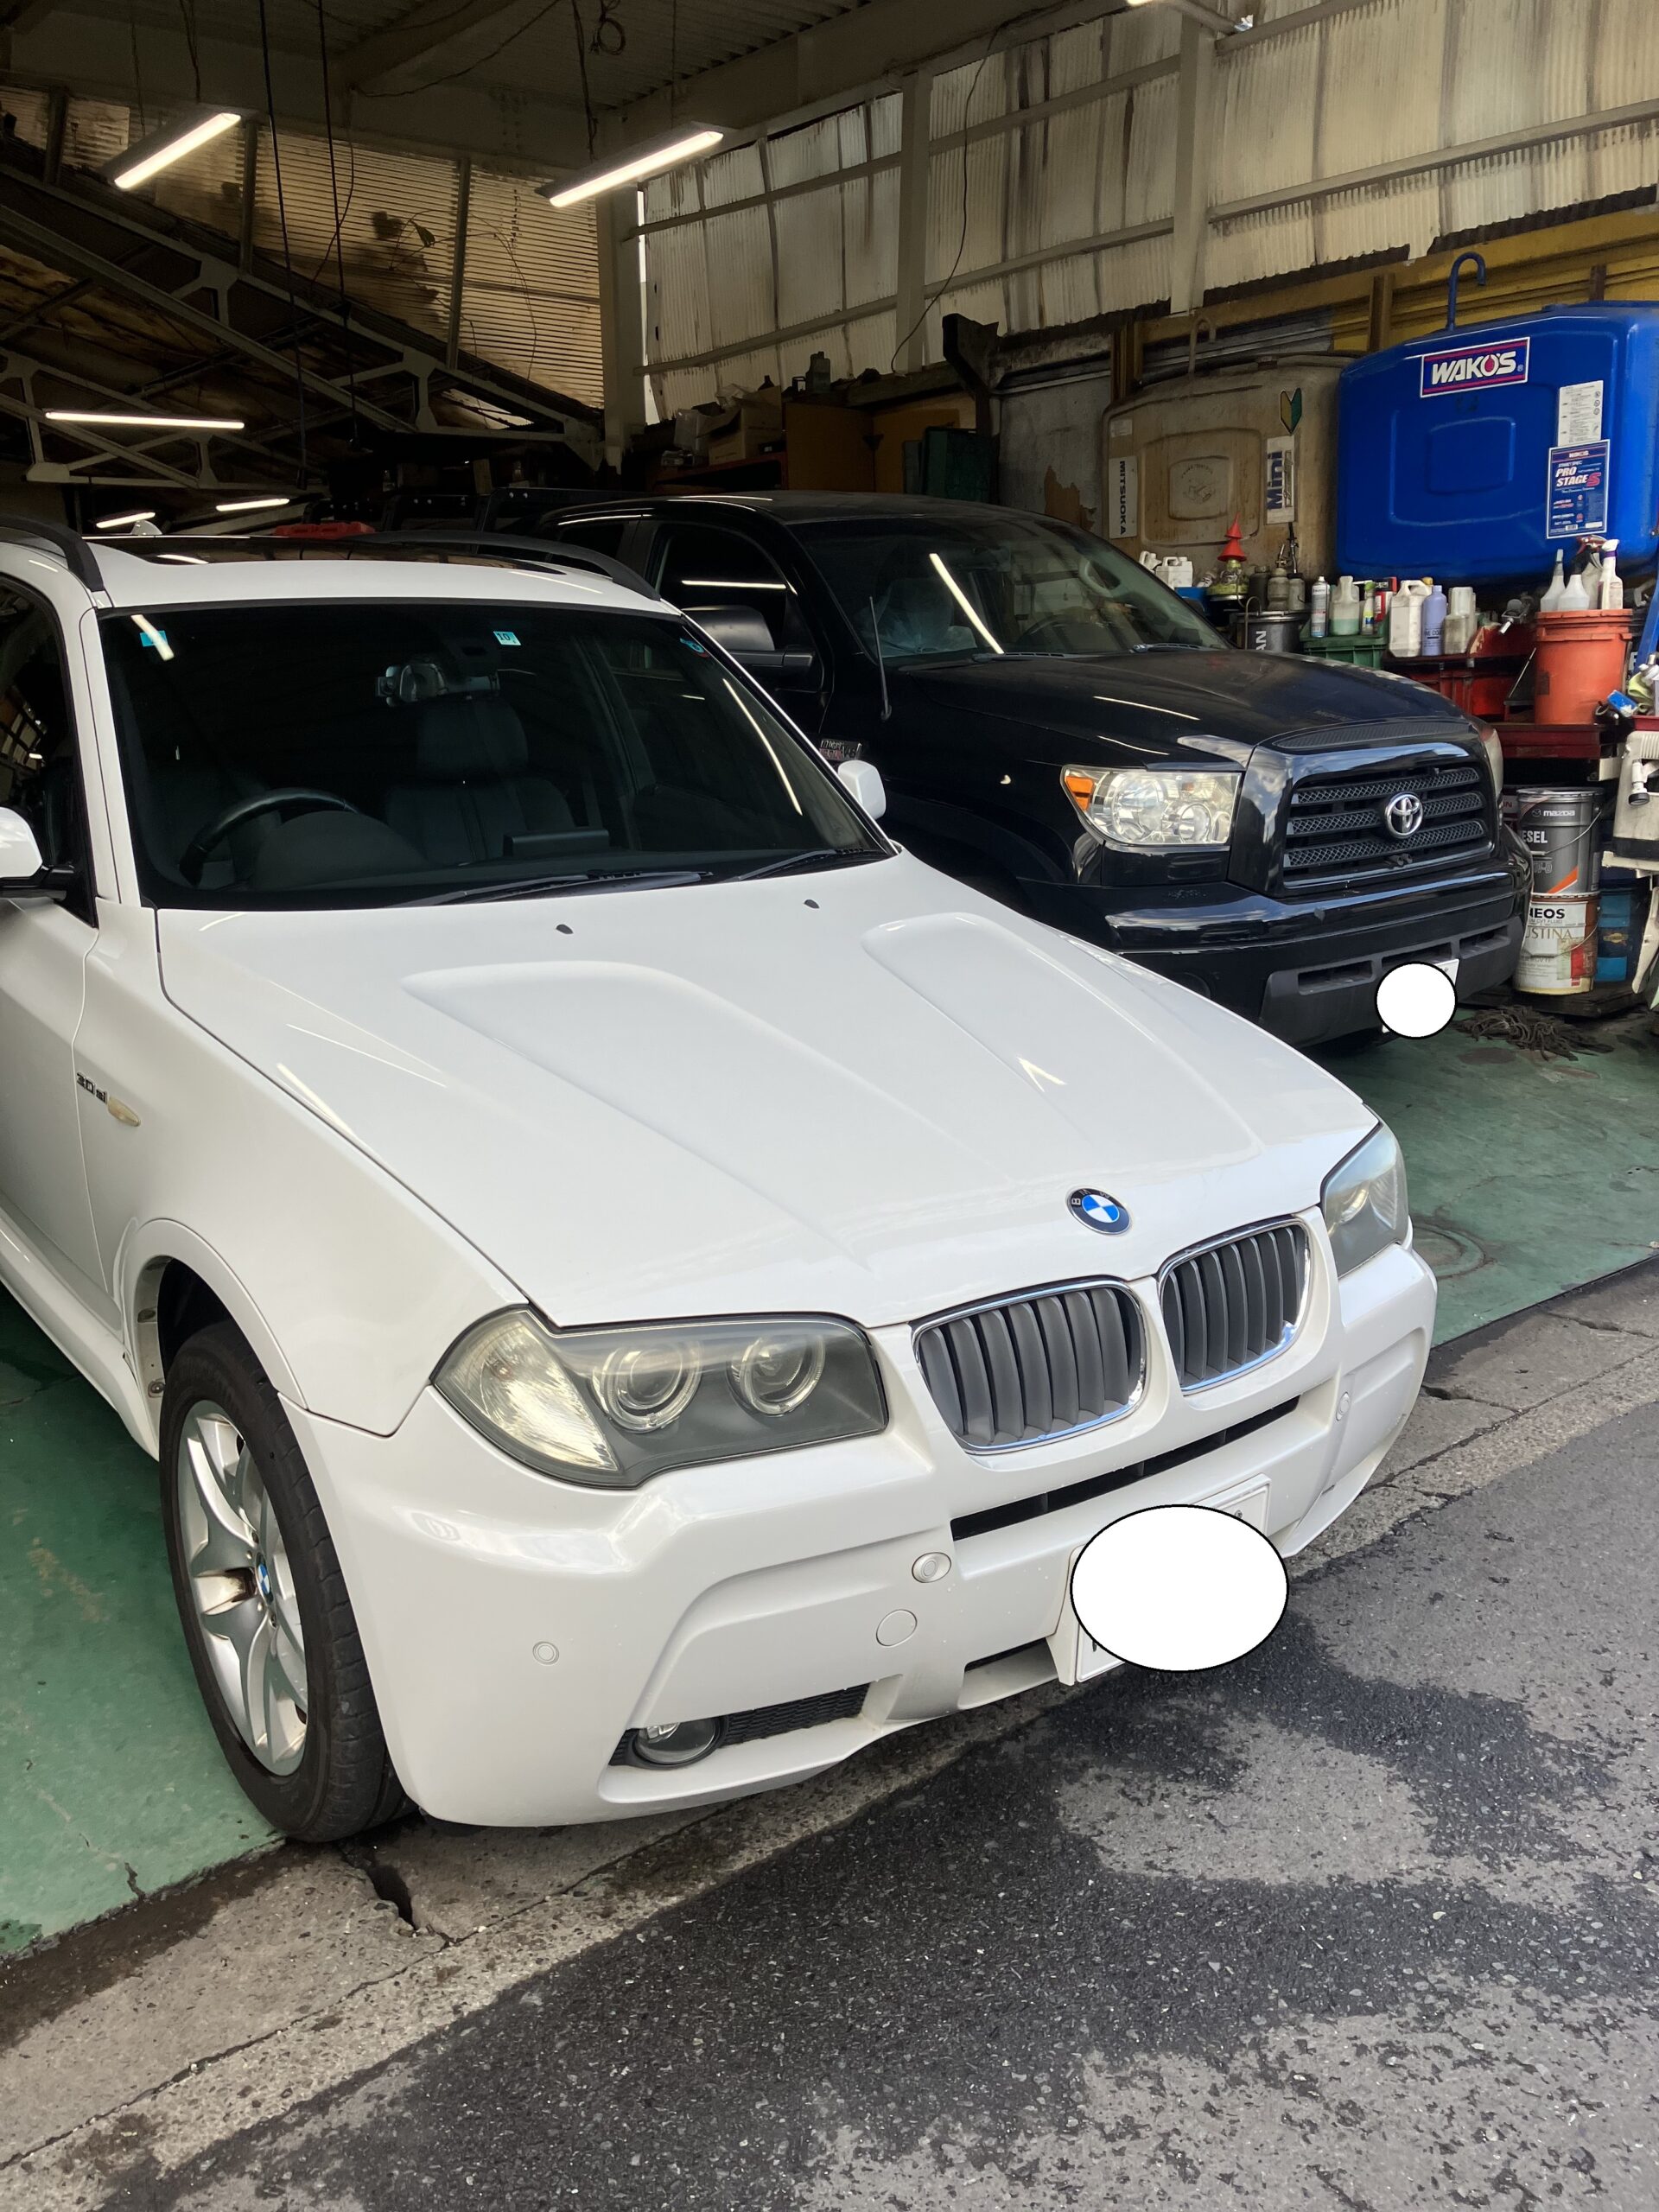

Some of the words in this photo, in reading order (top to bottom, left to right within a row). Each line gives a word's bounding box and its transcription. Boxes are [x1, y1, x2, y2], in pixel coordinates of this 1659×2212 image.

[1555, 467, 1577, 477] PRO
[1267, 451, 1283, 510] Mini
[1556, 474, 1589, 486] STAGE
